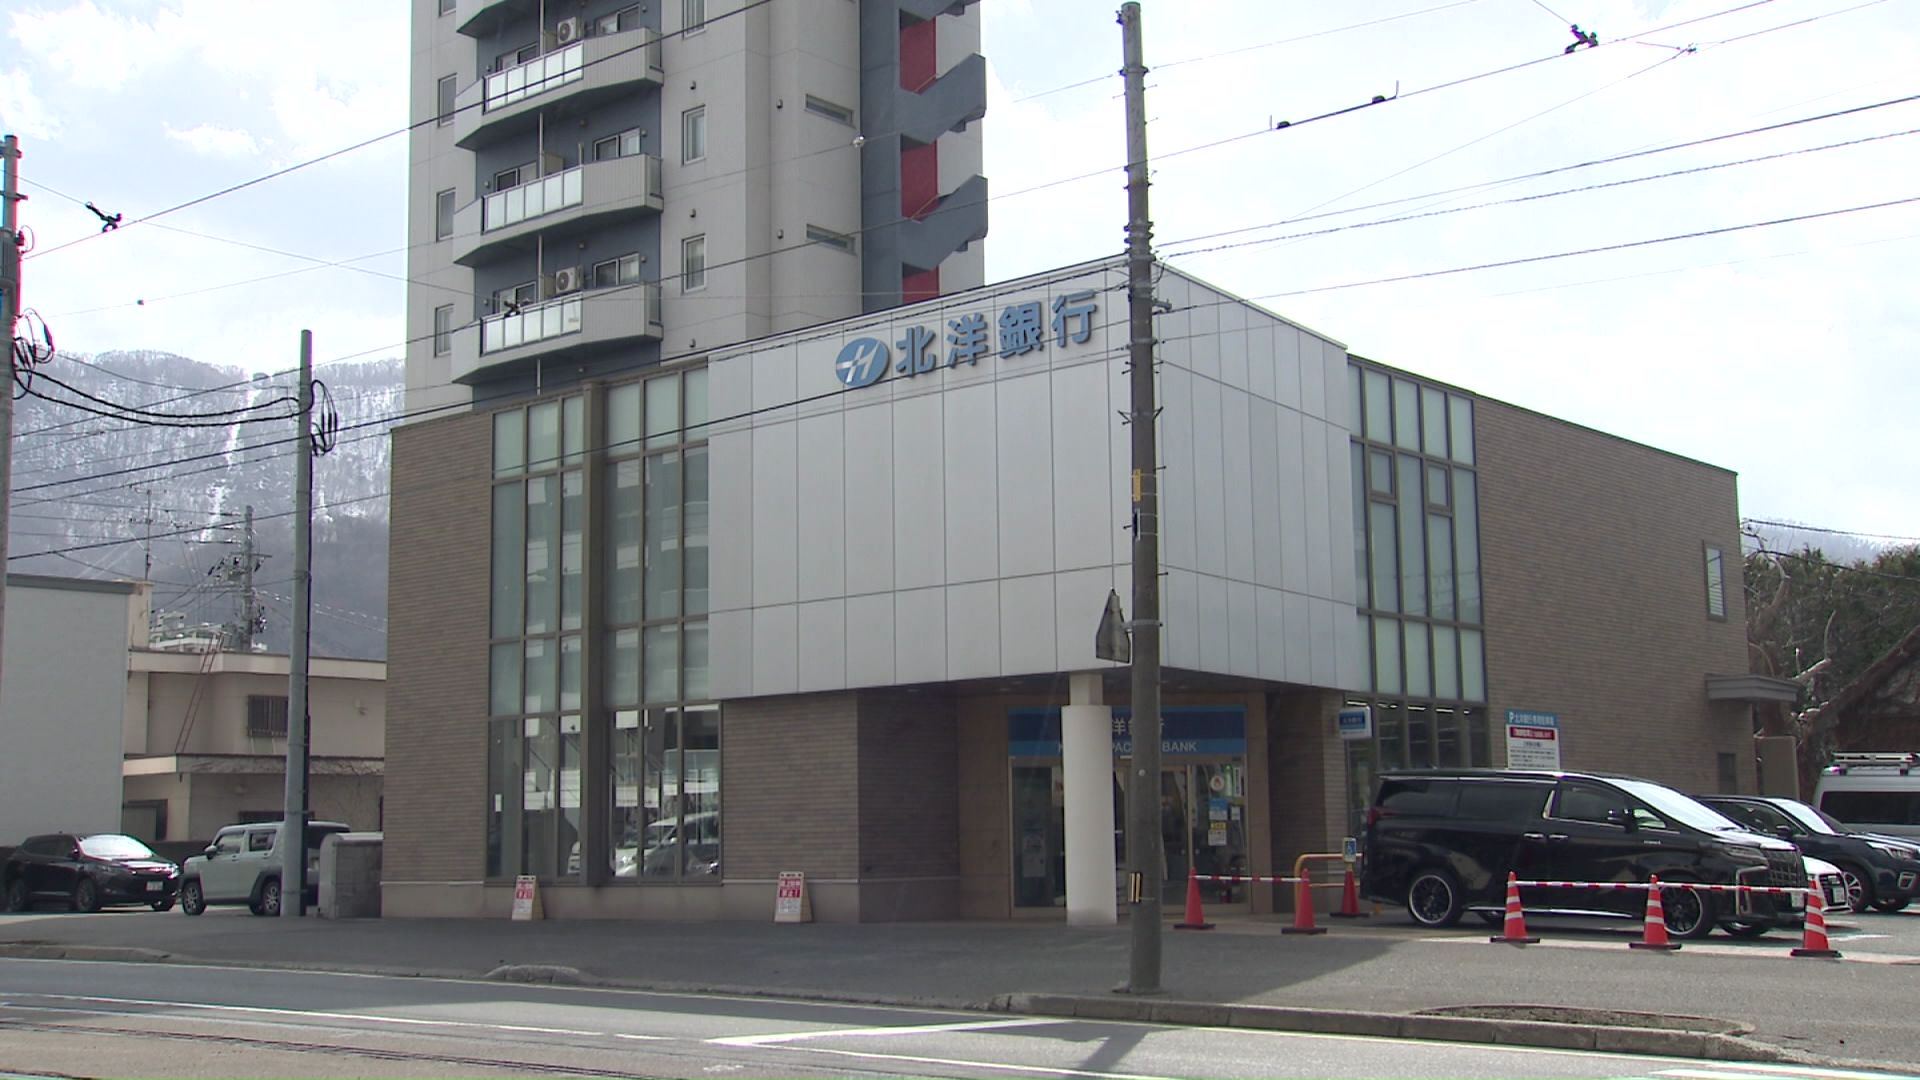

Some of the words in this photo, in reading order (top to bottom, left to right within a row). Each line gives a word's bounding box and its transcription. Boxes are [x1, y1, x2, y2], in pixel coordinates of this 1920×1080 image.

[896, 289, 1097, 378] 北洋銀行
[1162, 740, 1198, 753] BANK
